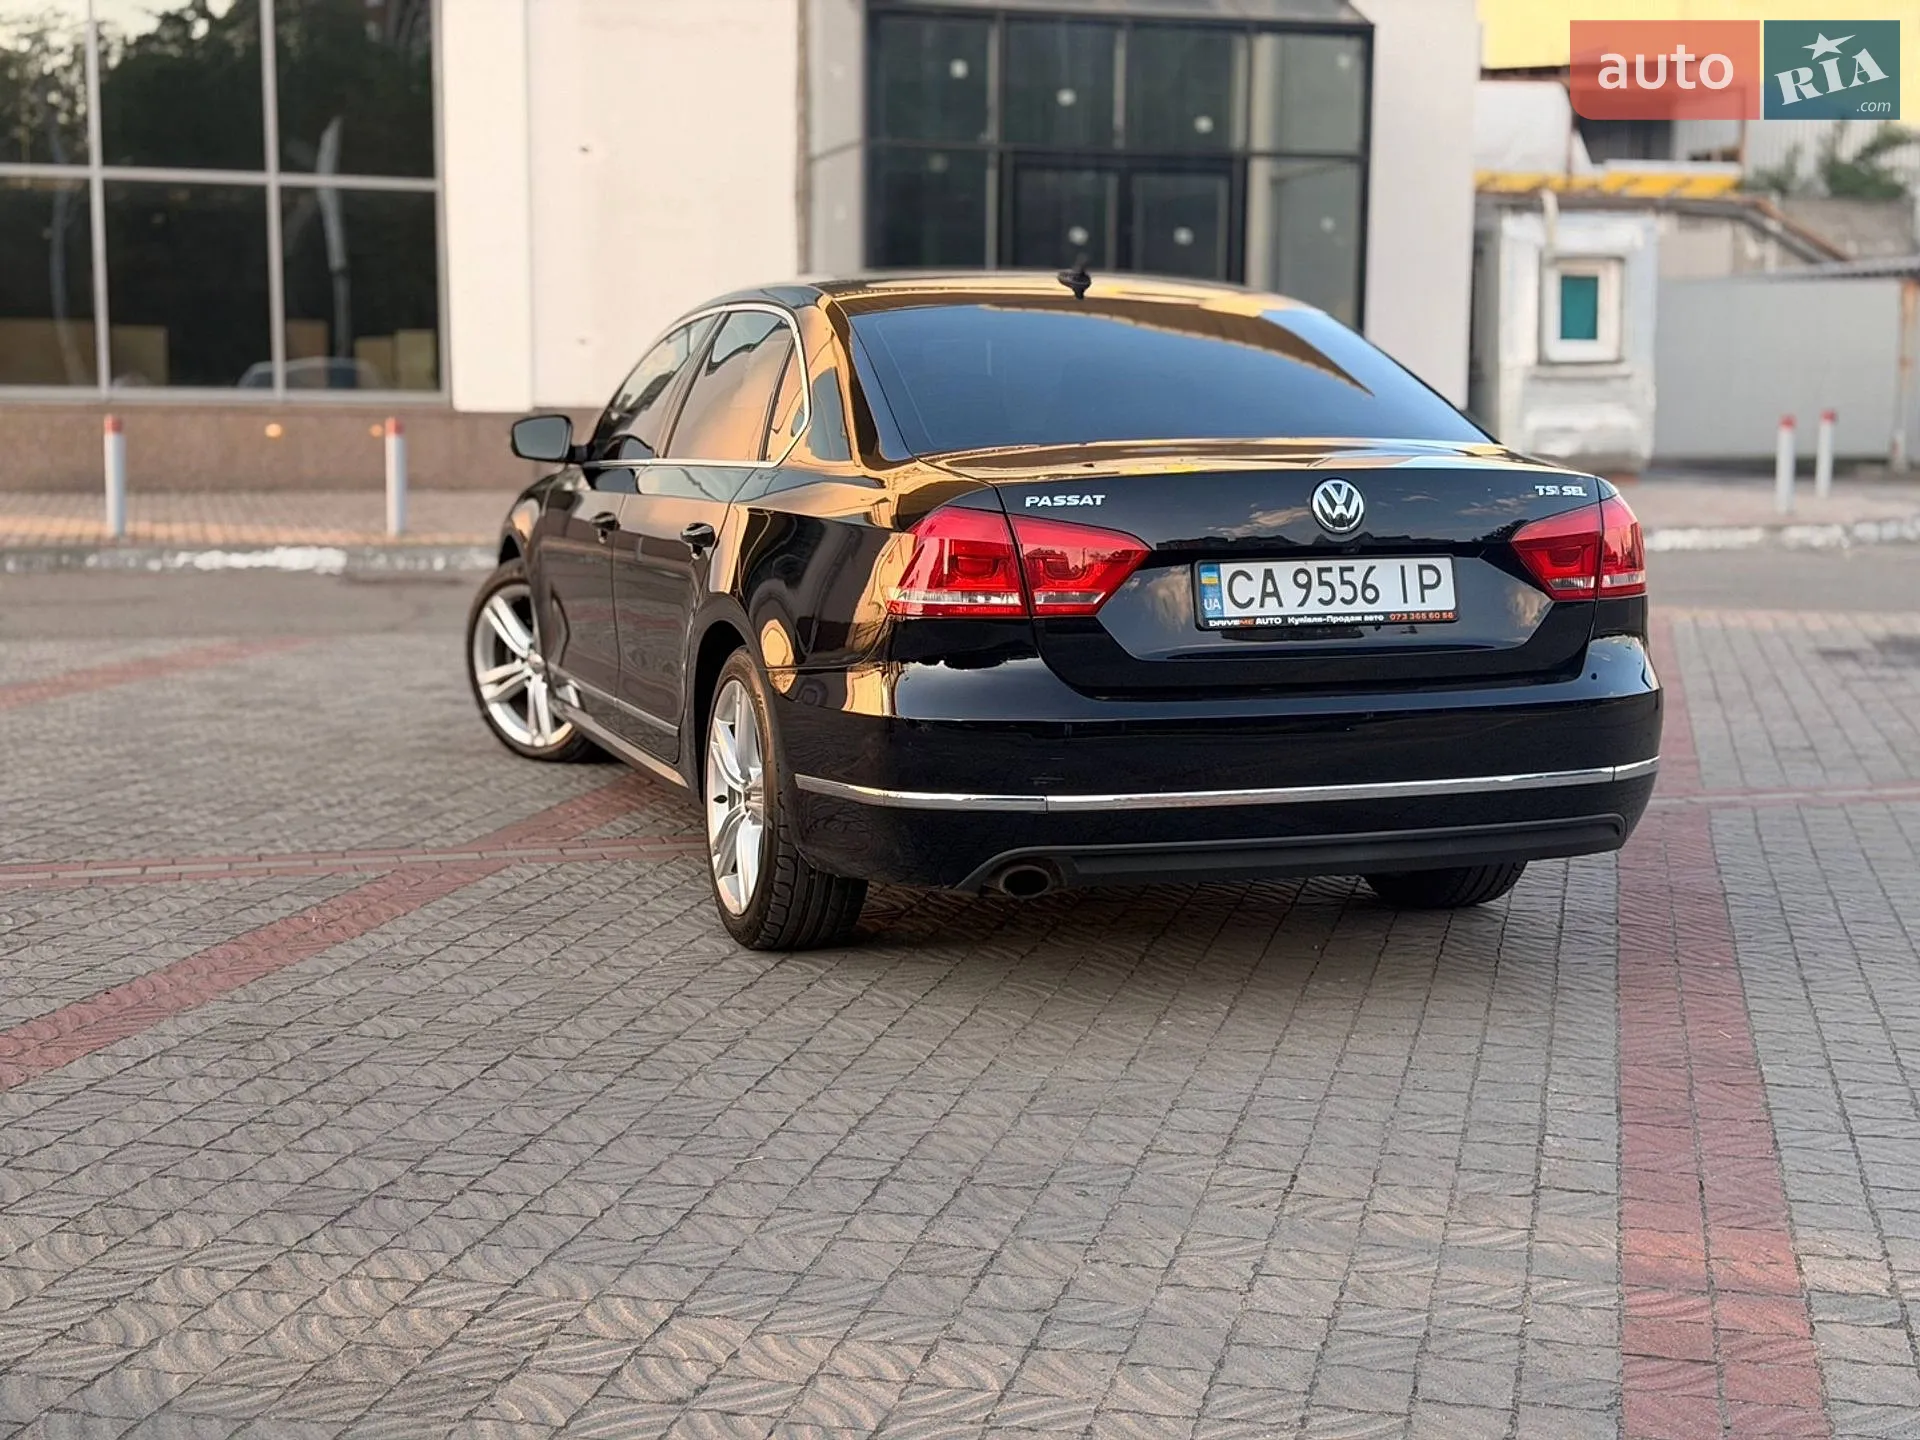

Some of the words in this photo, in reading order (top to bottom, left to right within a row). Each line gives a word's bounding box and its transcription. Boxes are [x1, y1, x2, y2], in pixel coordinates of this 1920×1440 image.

[1561, 485, 1587, 497] SEL
[1025, 494, 1105, 508] PASSAT
[1227, 568, 1284, 609] CA
[1292, 565, 1380, 607] 9556
[1399, 564, 1442, 604] IP
[1203, 598, 1221, 611] UA
[1256, 617, 1282, 625] AUTO
